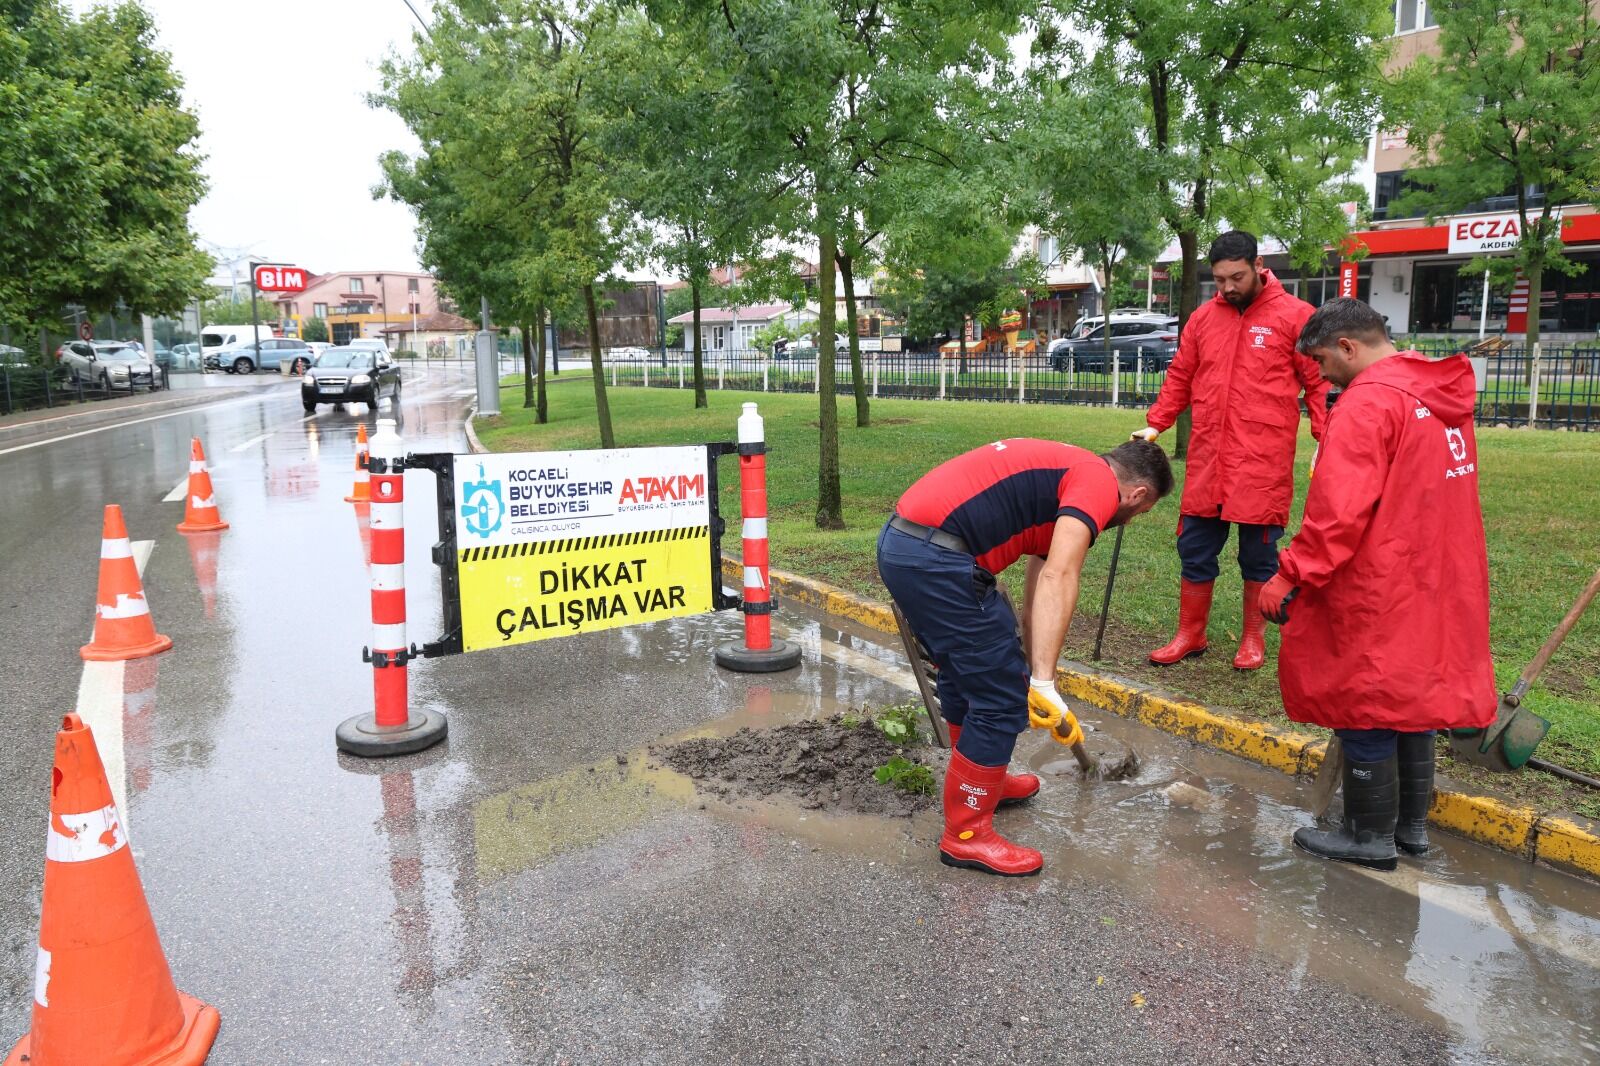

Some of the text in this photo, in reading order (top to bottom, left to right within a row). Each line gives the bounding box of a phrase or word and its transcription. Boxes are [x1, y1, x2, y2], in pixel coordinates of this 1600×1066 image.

[1456, 215, 1550, 240] ECZA
[260, 268, 303, 288] BİM
[1343, 269, 1352, 297] ECZ
[509, 467, 568, 482] KOCAELİ
[509, 480, 613, 500] BÜYÜKŞEHİR
[619, 474, 704, 504] A-TAKIMI
[511, 500, 589, 517] BELEDİYESİ
[539, 558, 647, 595] DİKKAT
[496, 585, 686, 641] ÇALIŞMA VAR
